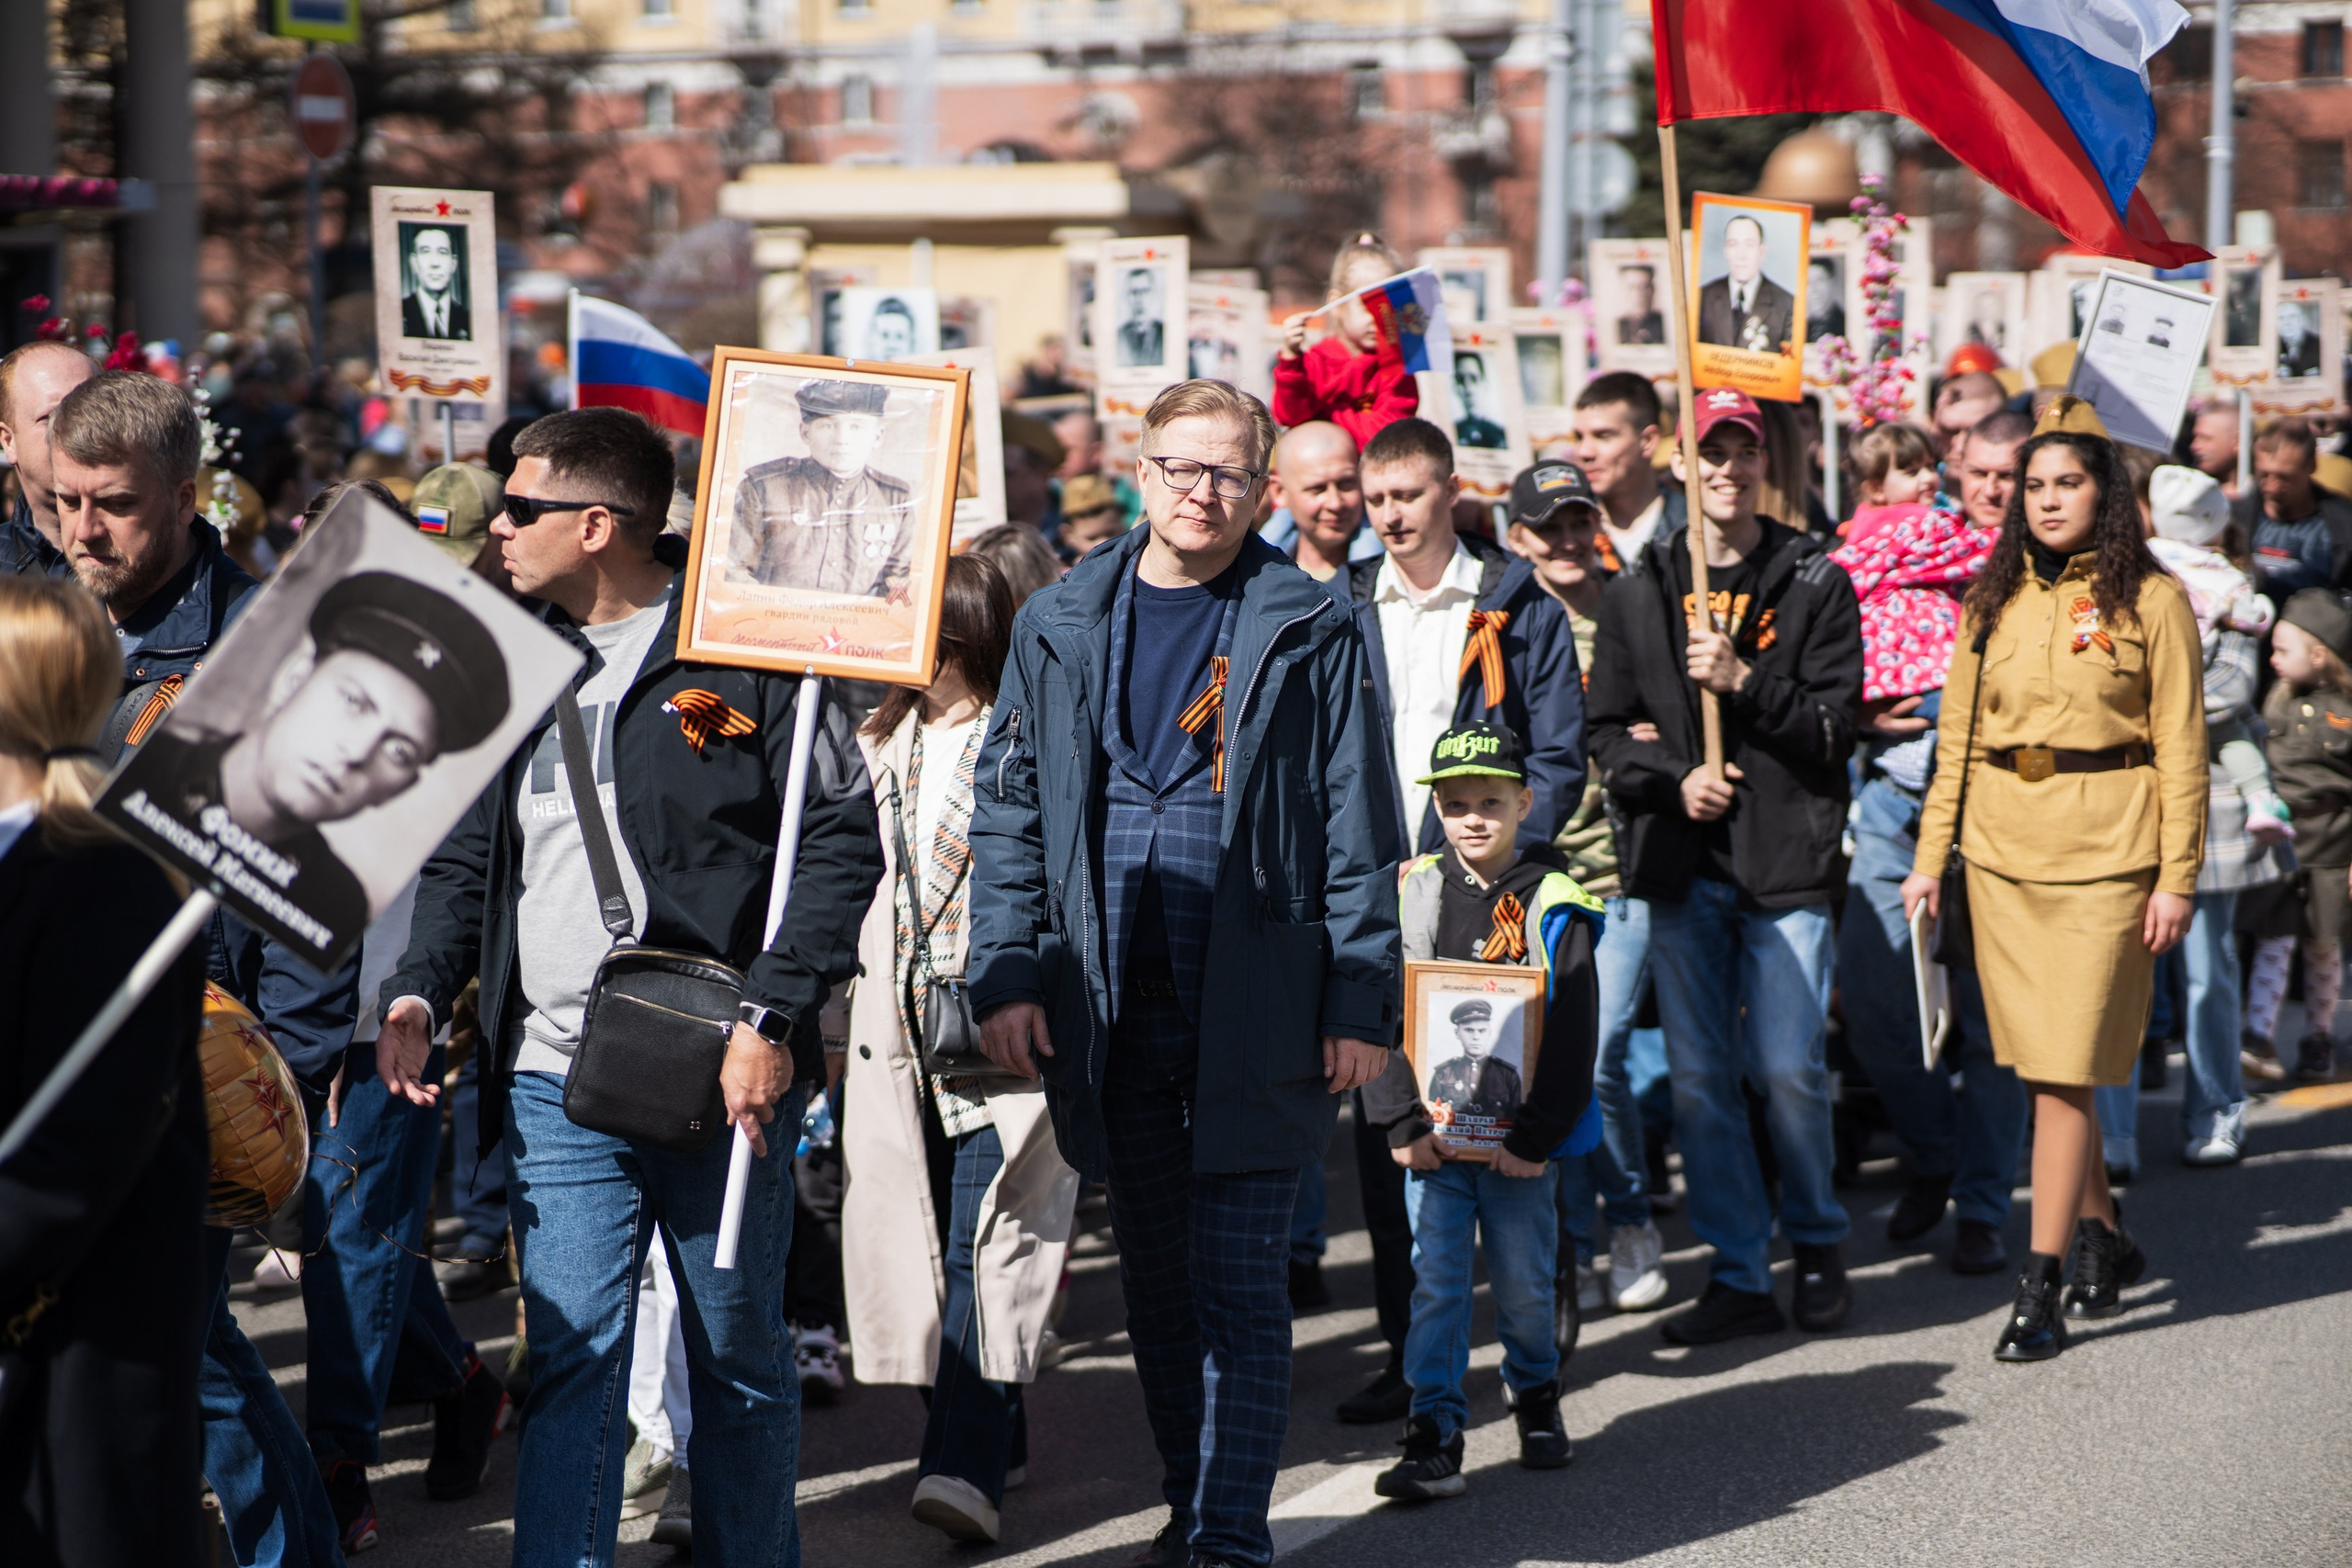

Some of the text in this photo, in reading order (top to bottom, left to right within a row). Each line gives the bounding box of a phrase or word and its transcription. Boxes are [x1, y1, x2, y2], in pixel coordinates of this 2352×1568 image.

[737, 590, 889, 616] Лапин Федор Алексеевич
[764, 609, 860, 626] гвардии рядовой
[531, 796, 577, 818] HELL
[119, 788, 334, 951] Алексей Матвеевич
[1474, 1125, 1510, 1137] ПЕТРО
